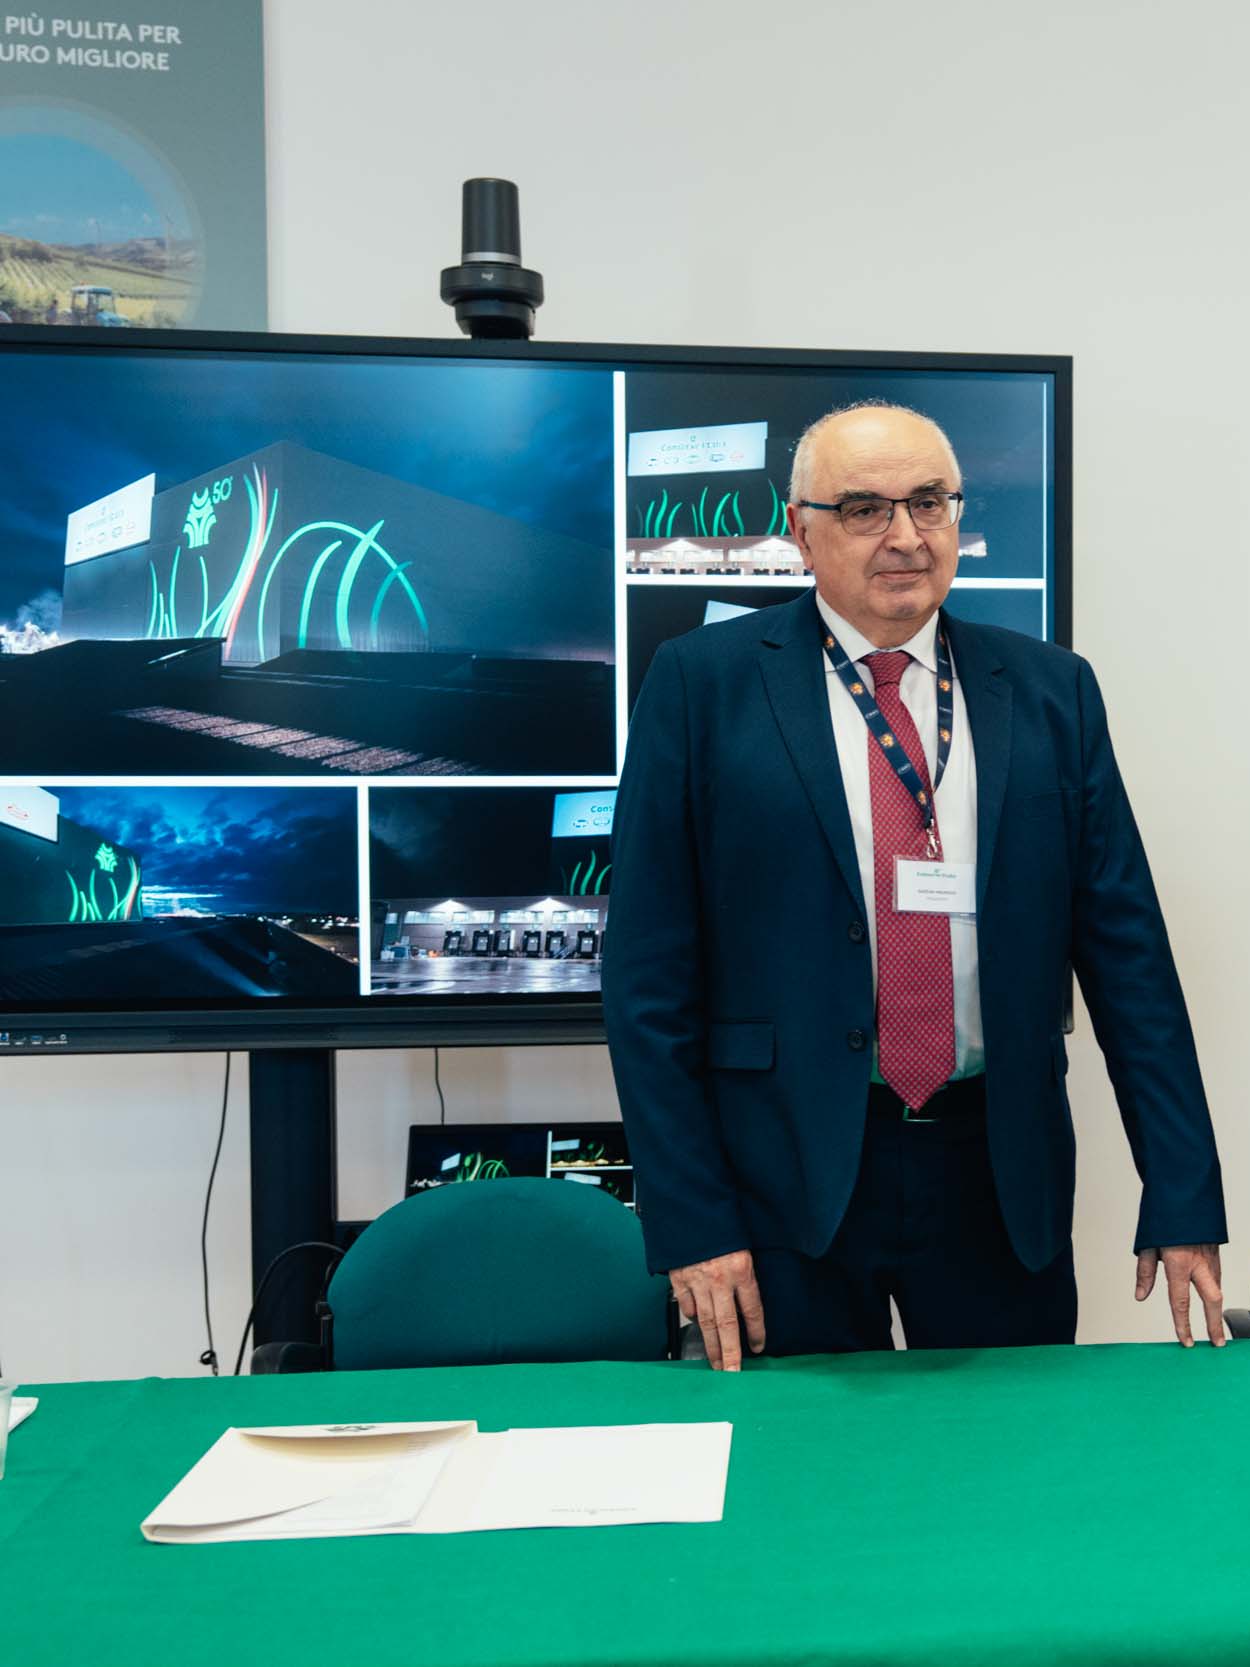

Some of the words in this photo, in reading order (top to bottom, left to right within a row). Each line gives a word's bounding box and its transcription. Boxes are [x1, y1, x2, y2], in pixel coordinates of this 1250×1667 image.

[5, 13, 44, 36] PIÙ
[51, 19, 133, 42] PULITA
[138, 24, 182, 45] PER
[57, 47, 170, 71] MIGLIORE
